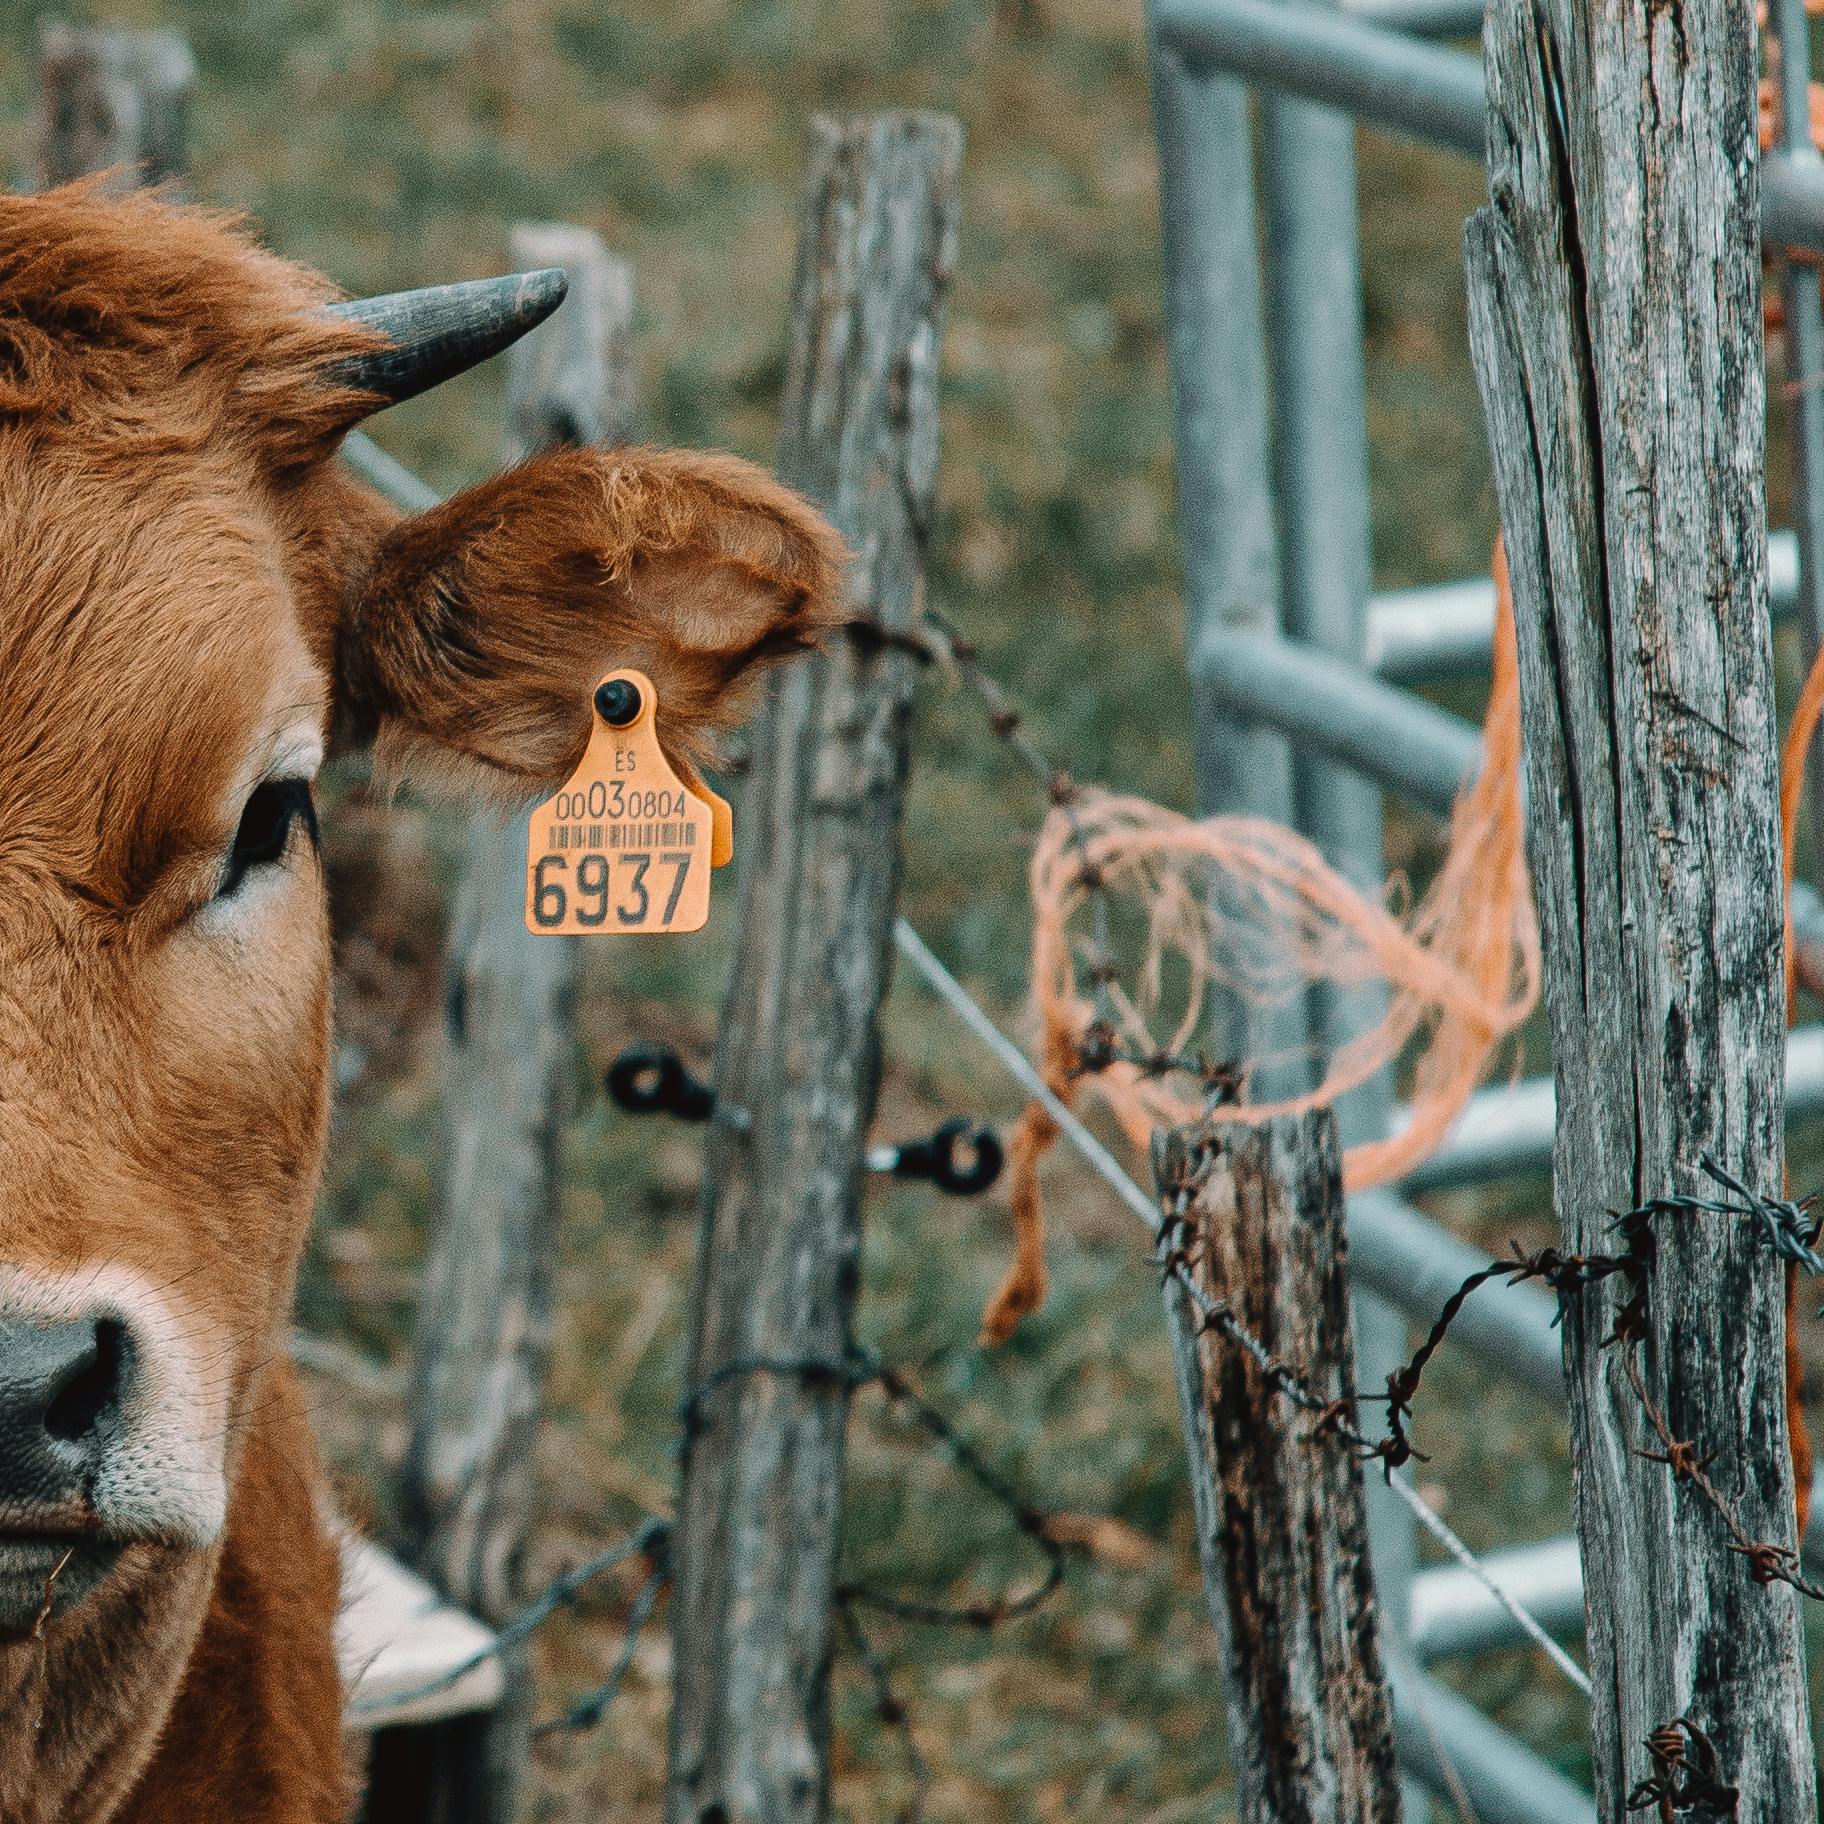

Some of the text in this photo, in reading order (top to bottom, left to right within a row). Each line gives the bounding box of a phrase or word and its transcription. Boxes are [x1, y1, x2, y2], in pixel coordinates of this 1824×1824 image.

[615, 750, 636, 772] ES
[555, 780, 686, 820] 00030804
[533, 853, 692, 927] 6937
